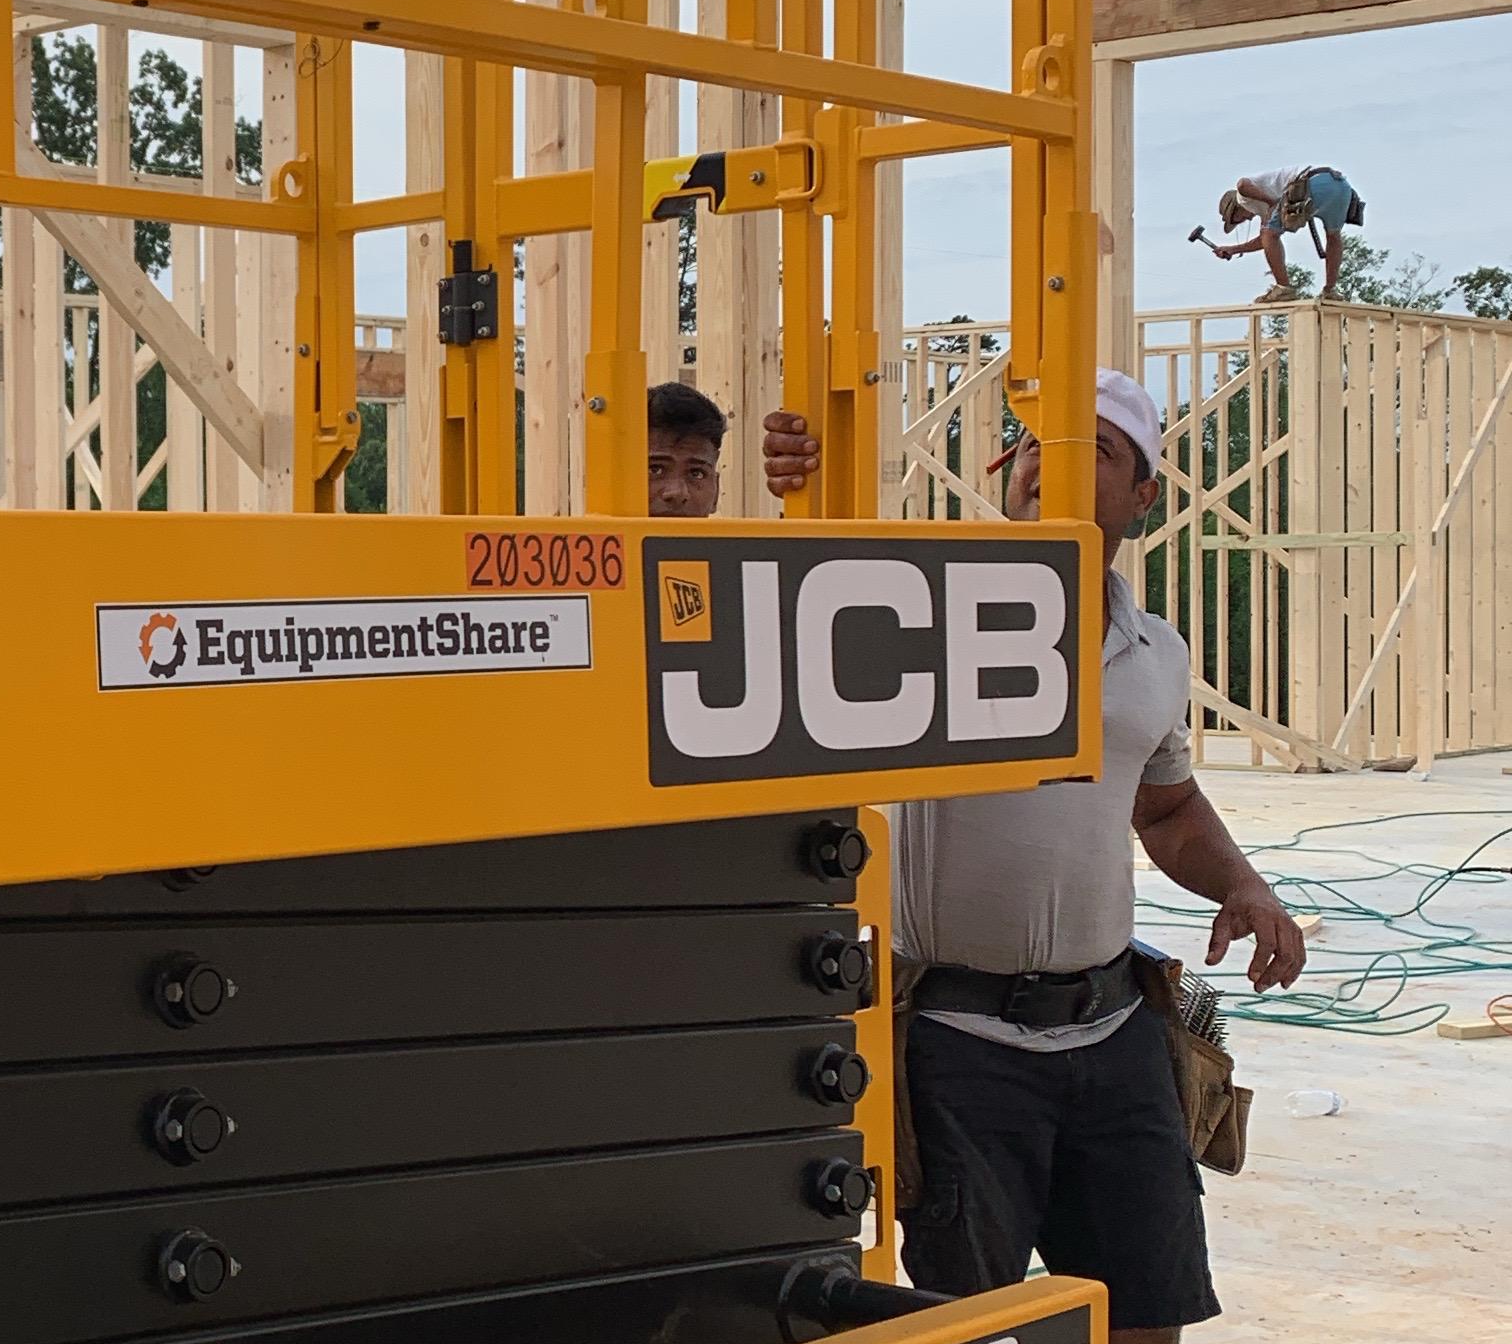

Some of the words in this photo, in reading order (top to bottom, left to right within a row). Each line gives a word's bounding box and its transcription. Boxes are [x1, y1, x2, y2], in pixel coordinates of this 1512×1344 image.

[469, 534, 623, 586] 203036
[672, 582, 702, 620] JCB
[196, 612, 550, 676] EquipmentShare
[661, 558, 1069, 758] JCB
